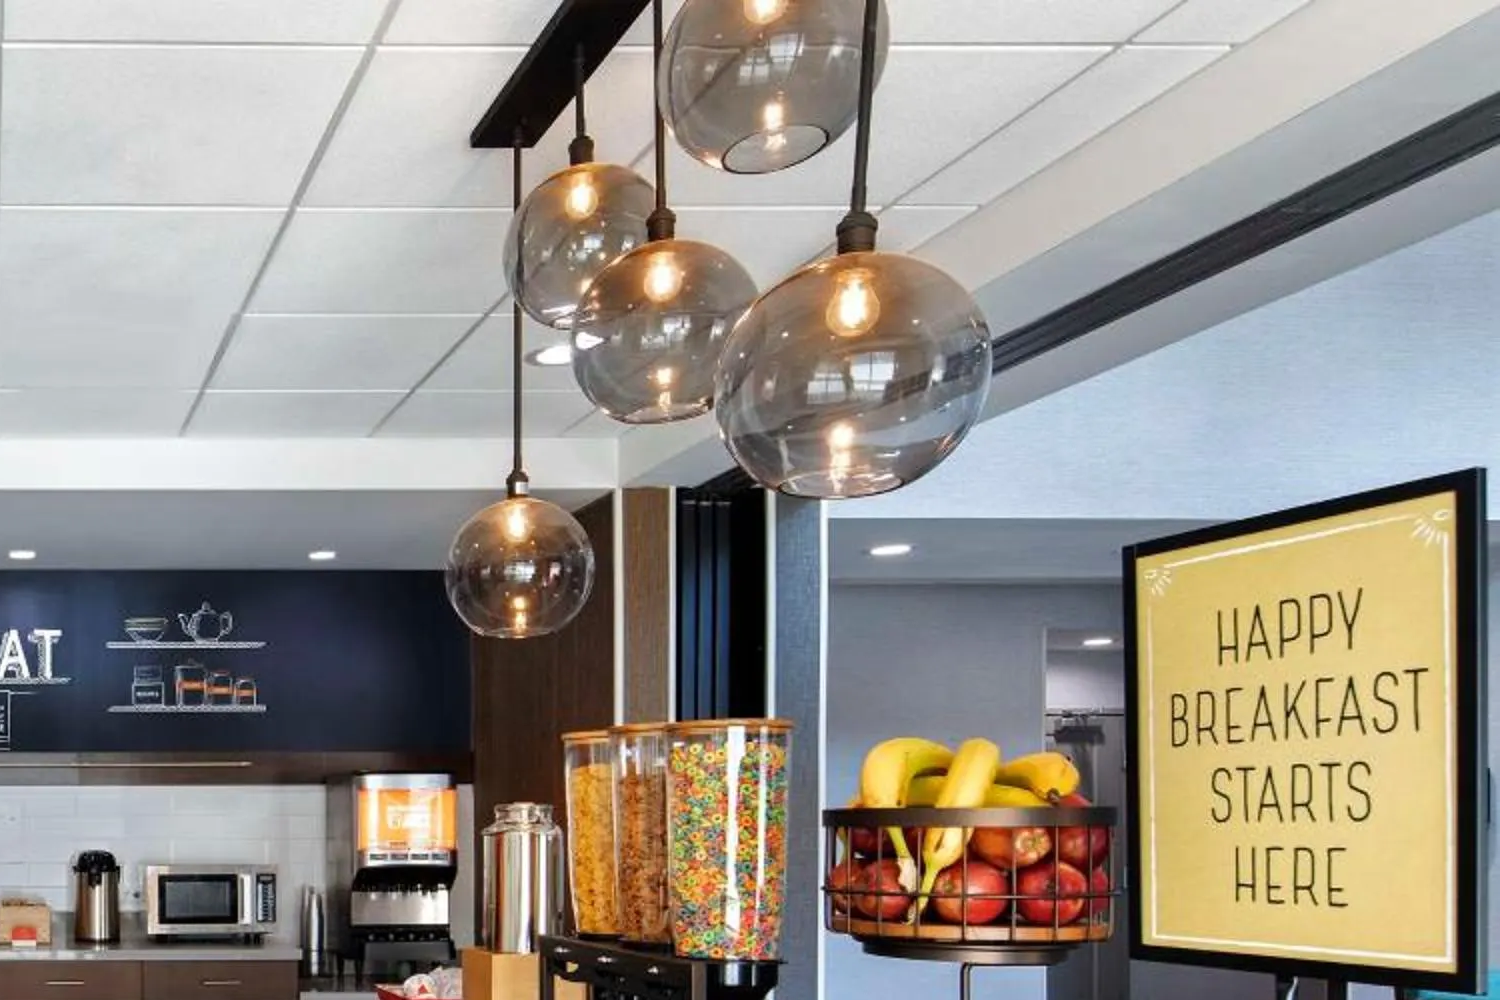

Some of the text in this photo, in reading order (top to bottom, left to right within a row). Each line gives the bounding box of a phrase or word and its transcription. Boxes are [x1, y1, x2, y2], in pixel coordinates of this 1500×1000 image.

[1216, 586, 1364, 667] HAPPY
[1170, 667, 1430, 749] BREAKFAST
[1210, 760, 1374, 824] STARTS
[1234, 845, 1350, 908] HERE
